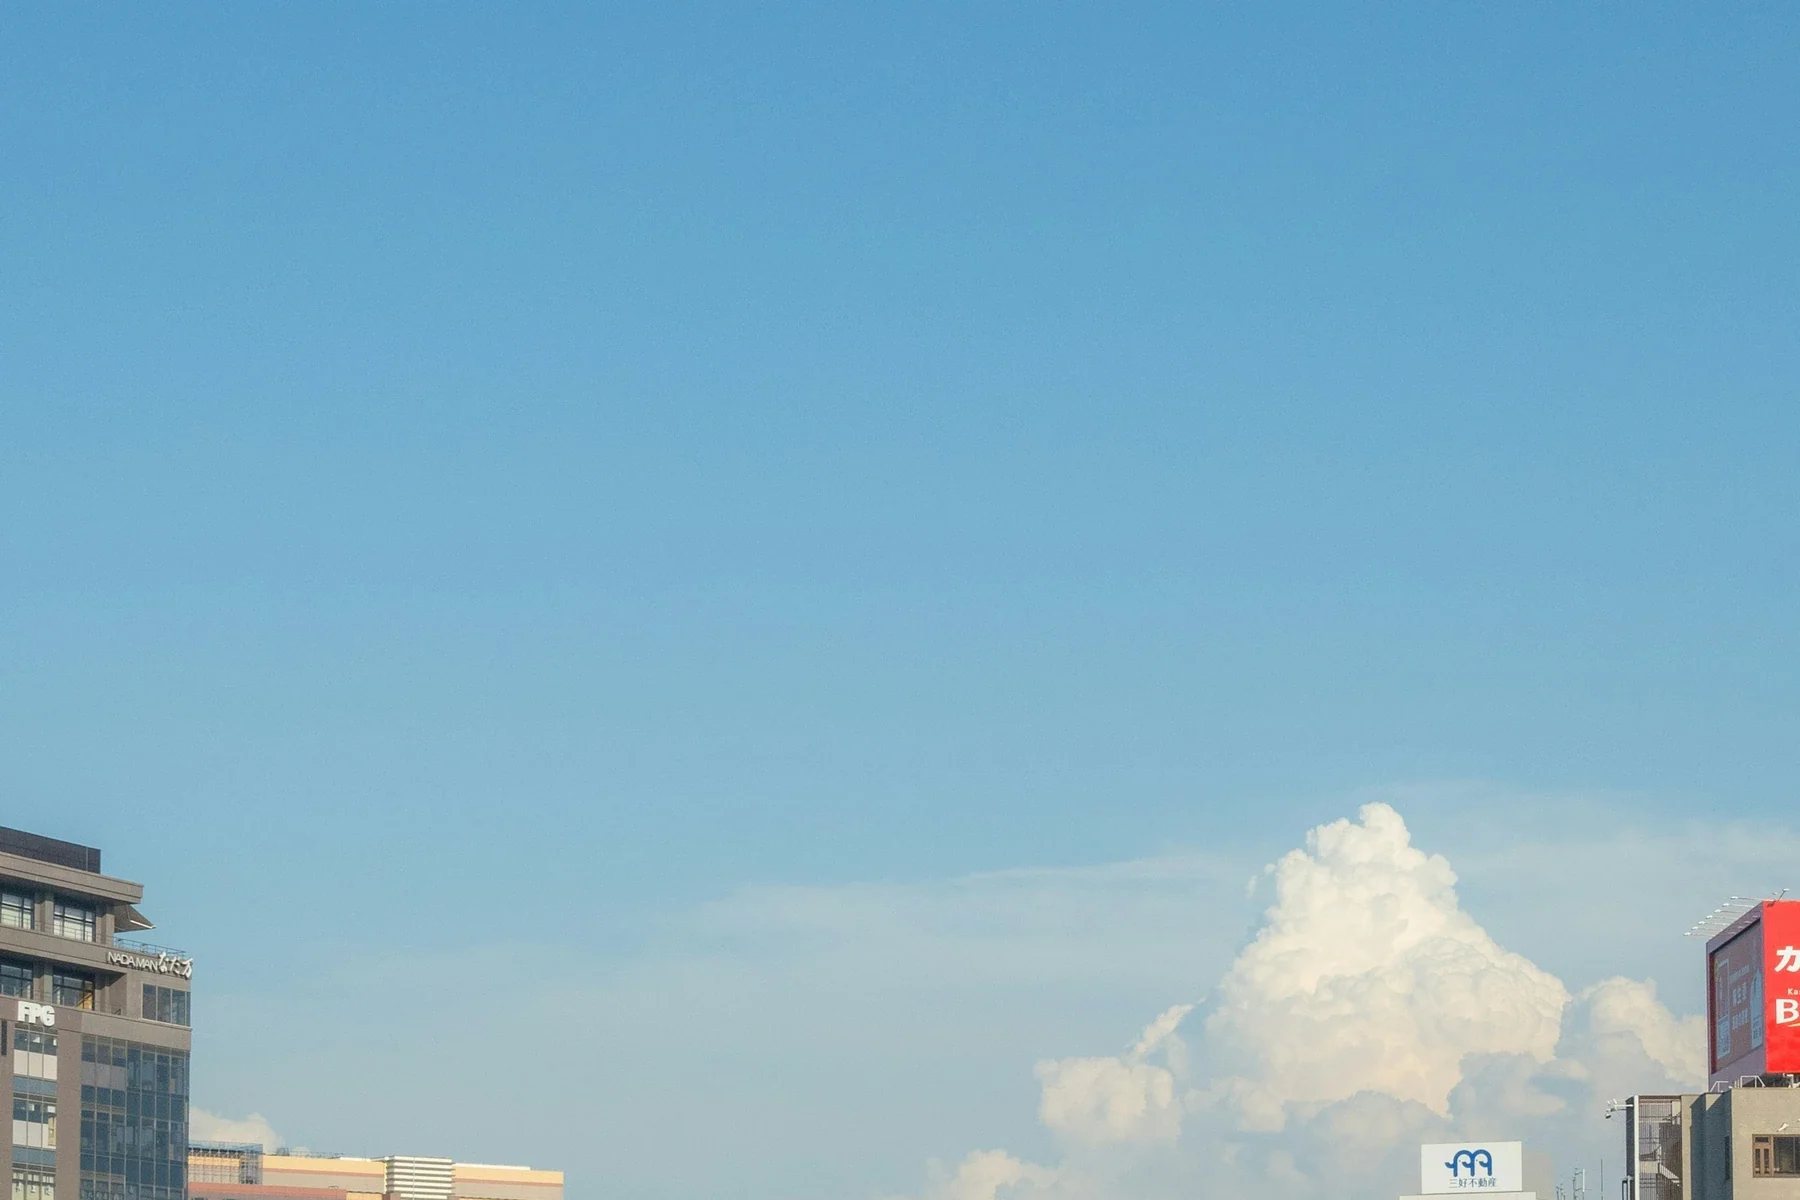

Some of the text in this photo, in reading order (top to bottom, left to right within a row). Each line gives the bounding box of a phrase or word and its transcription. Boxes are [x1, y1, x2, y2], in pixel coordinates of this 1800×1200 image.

[107, 952, 158, 971] NADAMAN
[18, 1000, 56, 1027] FPG
[1449, 1177, 1497, 1189] 三好不動産
